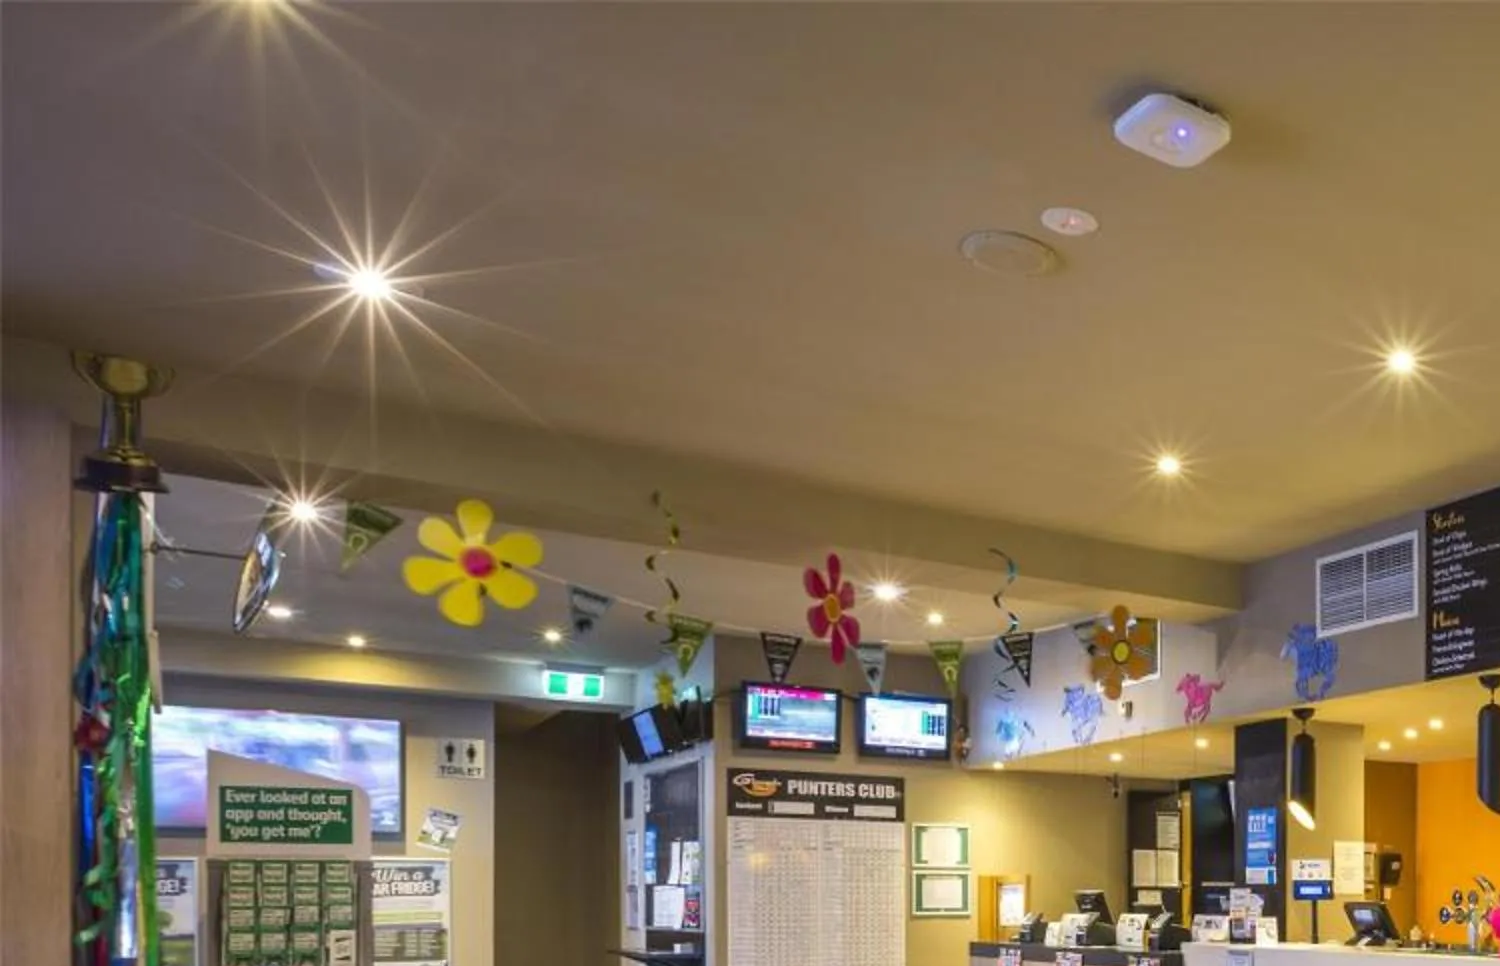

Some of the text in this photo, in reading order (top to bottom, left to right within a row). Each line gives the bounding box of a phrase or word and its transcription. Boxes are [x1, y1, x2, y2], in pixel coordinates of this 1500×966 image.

[439, 765, 482, 776] TOILET
[787, 779, 855, 797] PUNTERS
[858, 782, 896, 798] CLUB
[225, 789, 347, 805] Ever looked at an
[225, 806, 347, 825] app and thought,
[261, 825, 285, 840] get
[372, 869, 425, 882] Win a
[373, 883, 391, 895] AR
